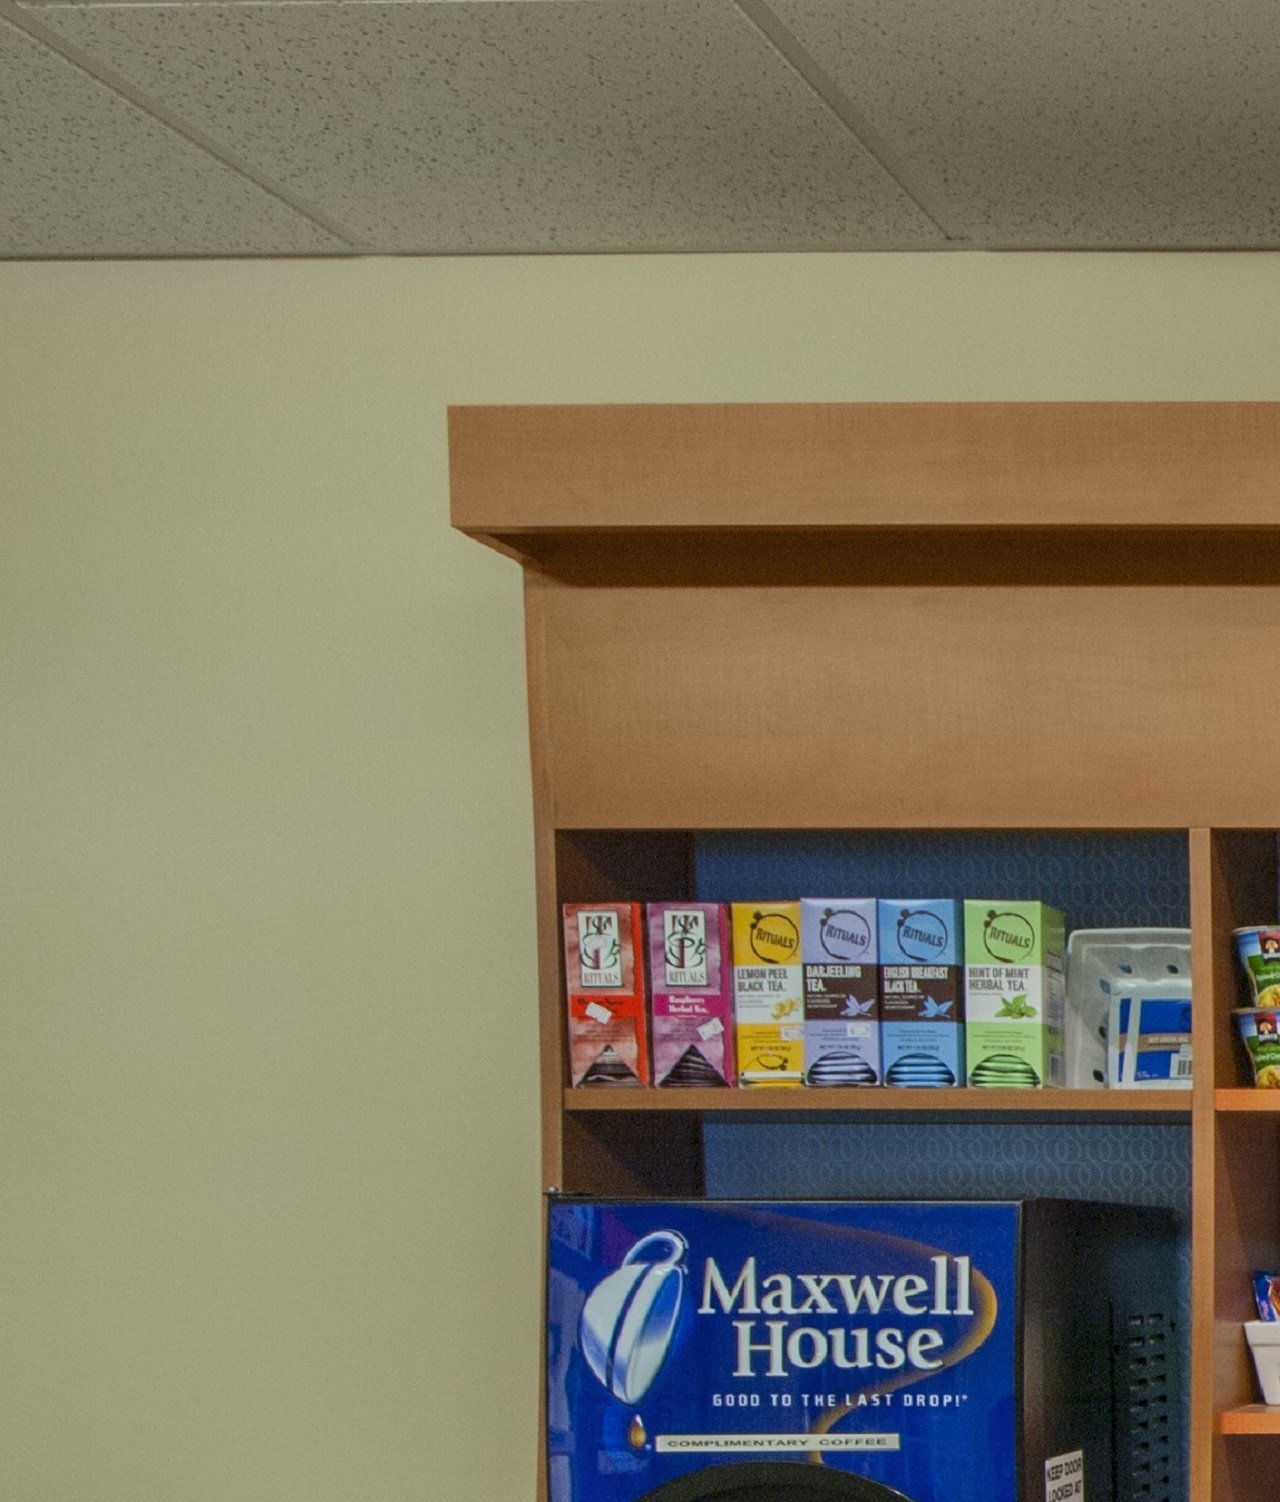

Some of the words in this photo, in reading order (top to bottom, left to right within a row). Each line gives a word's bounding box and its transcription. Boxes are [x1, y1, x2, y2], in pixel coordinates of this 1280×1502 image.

[755, 927, 794, 949] RITUALS
[825, 924, 867, 947] RITUALS
[902, 924, 944, 947] RITUALS
[989, 928, 1031, 950] RITUALS
[584, 972, 620, 985] RITUALS
[668, 970, 706, 984] RITUALS
[737, 967, 767, 980] LEMON
[767, 967, 788, 979] PEEL
[806, 966, 862, 979] DARJEELING
[884, 967, 910, 979] ENGLISH
[911, 966, 948, 979] BREAKFAST
[968, 967, 990, 979] HINT
[992, 967, 1003, 978] OF
[1005, 967, 1030, 979] MINT
[738, 980, 765, 992] BLACK
[884, 980, 904, 993] BLACK
[968, 979, 1004, 991] HERBAL
[697, 1254, 975, 1316] Maxwell
[731, 1320, 945, 1378] House
[712, 1393, 761, 1407] GOOD
[770, 1393, 792, 1407] TO
[800, 1393, 837, 1407] THE
[845, 1393, 893, 1407] LAST
[666, 1438, 810, 1449] COMPLIMENTARY
[818, 1437, 888, 1447] COFFEE
[1064, 1457, 1082, 1476] DOOR
[1074, 1480, 1083, 1495] AT
